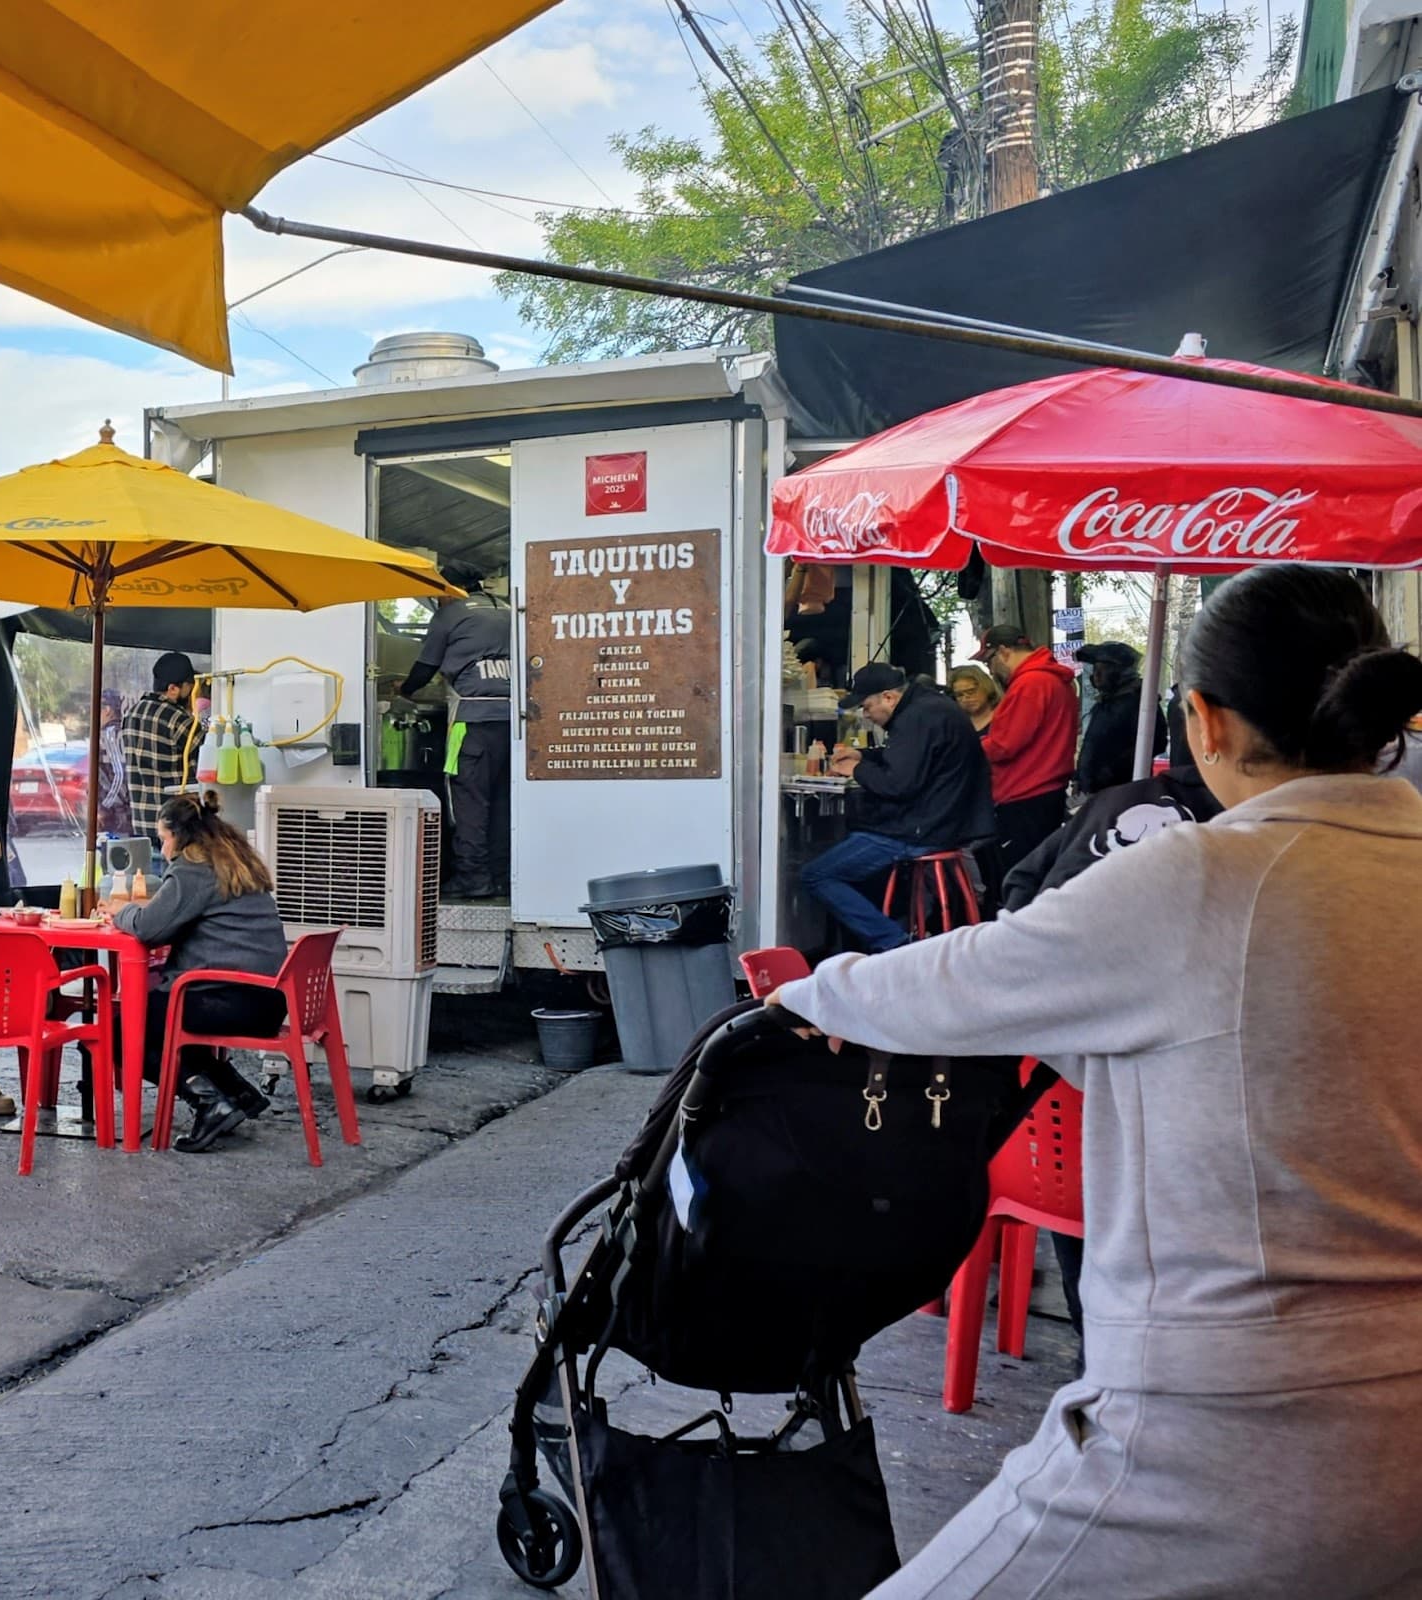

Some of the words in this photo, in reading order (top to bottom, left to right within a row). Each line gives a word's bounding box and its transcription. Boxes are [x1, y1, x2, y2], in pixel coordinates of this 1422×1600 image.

[592, 472, 639, 485] MICHELIN
[604, 484, 626, 494] 2025
[4, 516, 106, 531] Chico
[1058, 487, 1319, 556] Coca-Cola
[550, 542, 694, 578] TAQUITOS
[610, 578, 632, 605] Y
[551, 608, 694, 640] TORTITAS
[599, 645, 642, 655] CABEZA
[593, 661, 650, 672] PICADILLO
[600, 678, 642, 688] PIERNA
[586, 693, 657, 704] CHICHARRON
[558, 710, 620, 721] FRIJOLITOS
[623, 710, 643, 719] CON
[647, 709, 685, 719] TOCINO
[562, 727, 609, 737] HUEVITO
[612, 726, 631, 736] CON
[635, 726, 682, 736] CHORIZO
[548, 743, 590, 753] CHILITO
[593, 743, 642, 752] RELLENO
[645, 742, 659, 752] DE
[547, 759, 590, 769] CHILITO
[592, 759, 641, 769] RELLENO
[643, 759, 658, 768] DE
[660, 758, 698, 768] CARNE
